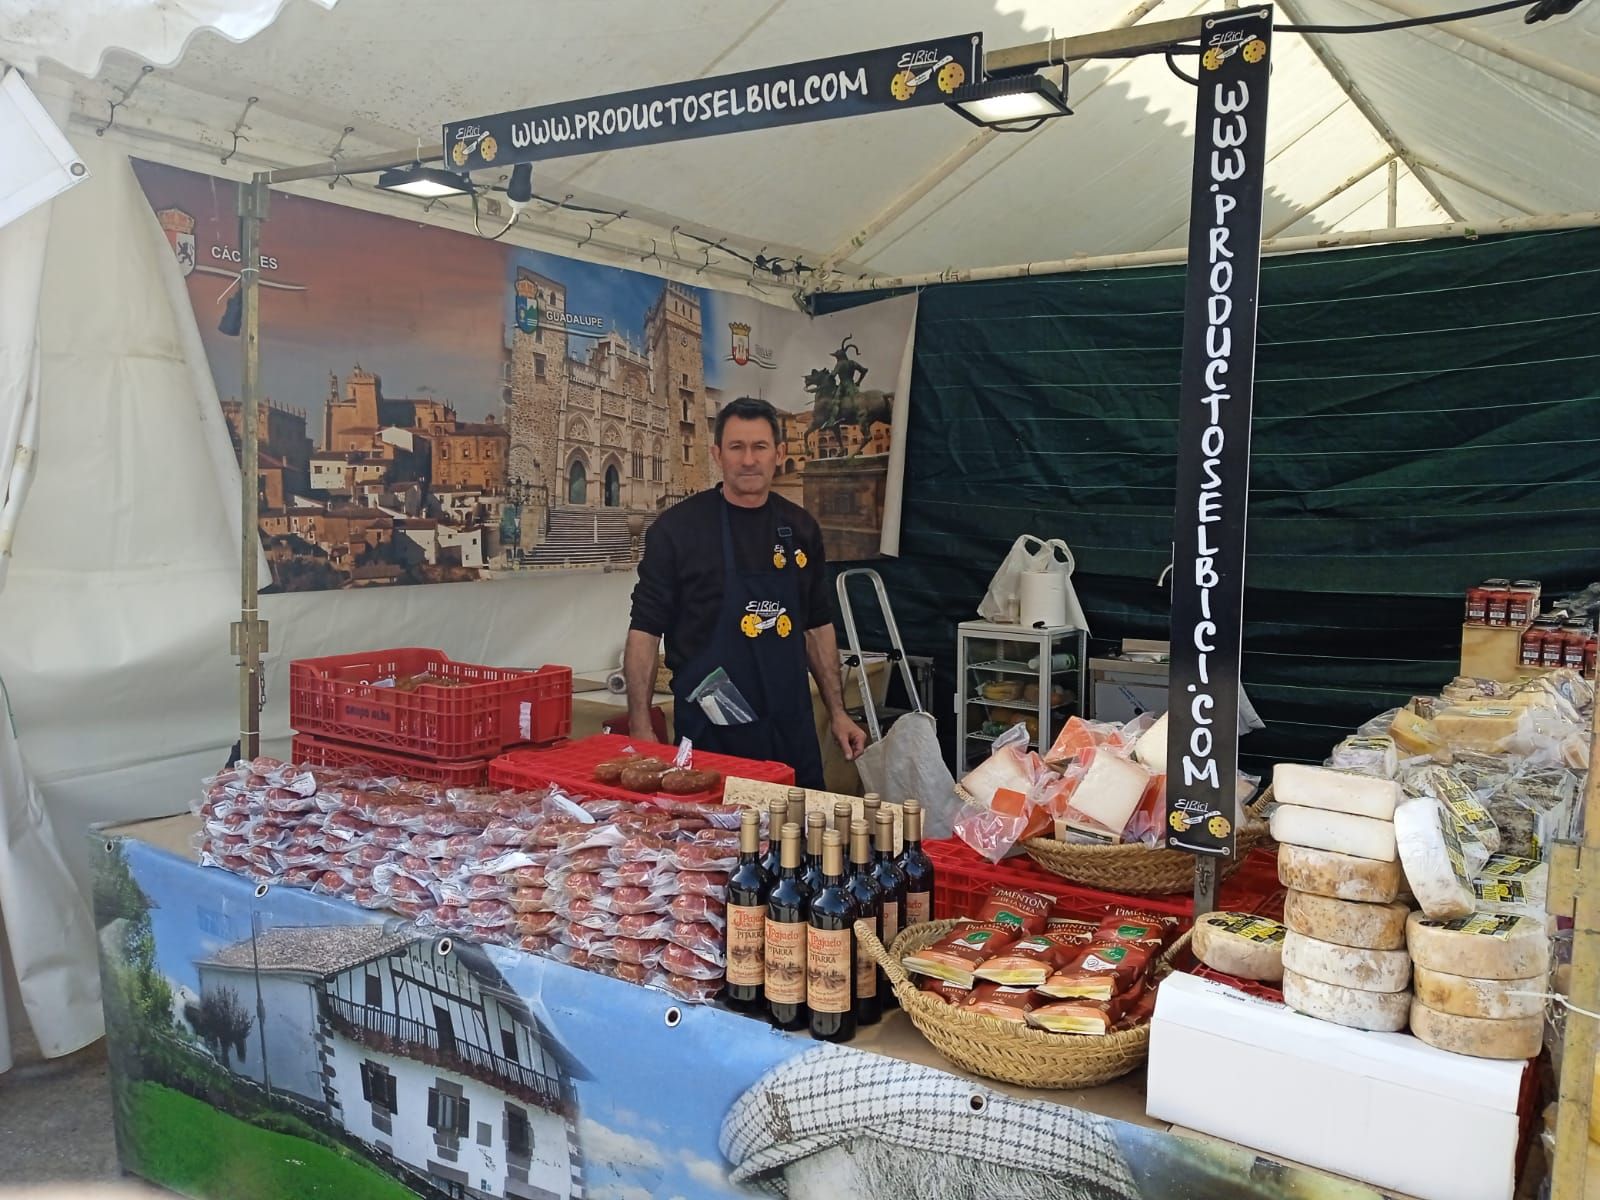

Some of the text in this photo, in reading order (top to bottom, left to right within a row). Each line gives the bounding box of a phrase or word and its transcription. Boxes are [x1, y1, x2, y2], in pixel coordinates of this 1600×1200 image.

[511, 67, 868, 149] WWW.PRODUCTOSELBICI.COM
[211, 245, 278, 270] CÁCES
[546, 311, 603, 328] GUADALUPE
[1182, 80, 1249, 789] WWW.PRODUCTOSELBICI.COM
